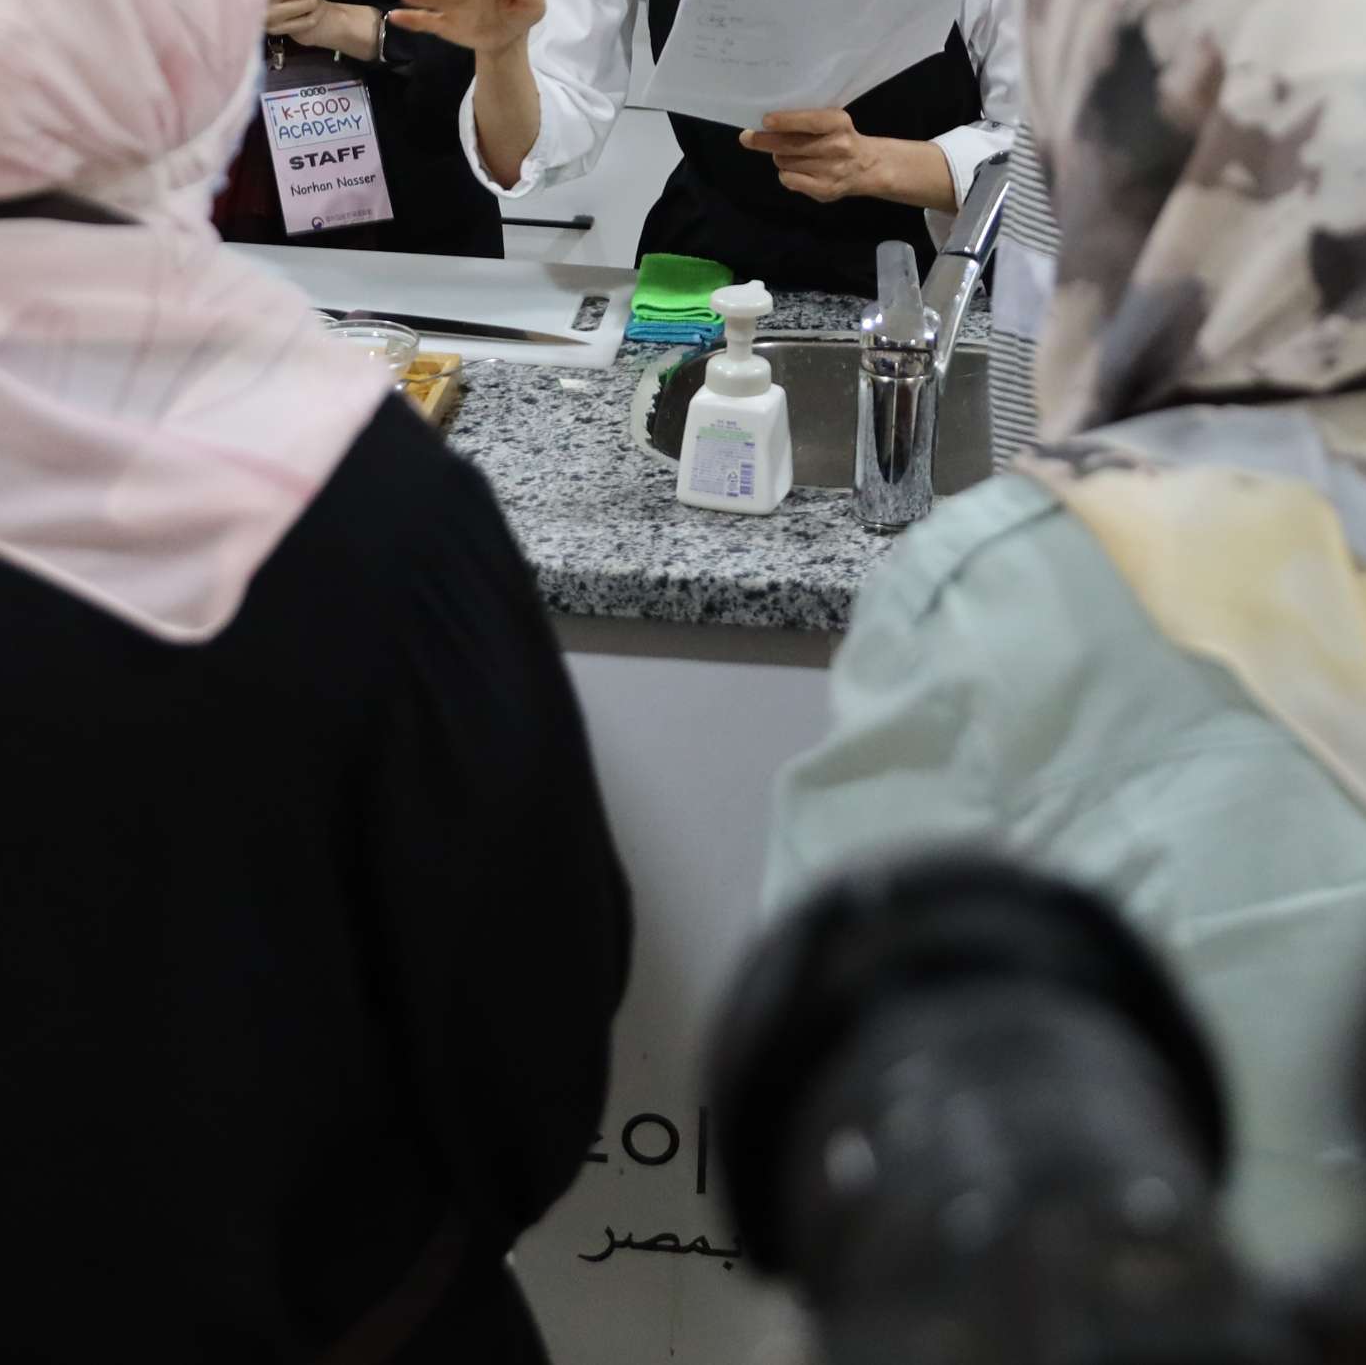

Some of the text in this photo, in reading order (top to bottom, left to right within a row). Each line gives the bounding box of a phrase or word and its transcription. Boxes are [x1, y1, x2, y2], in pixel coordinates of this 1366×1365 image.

[281, 97, 351, 121] K-FOOD
[278, 114, 363, 139] ACADEMY
[289, 145, 366, 170] STAFF
[290, 174, 377, 197] Norhan Nasser
